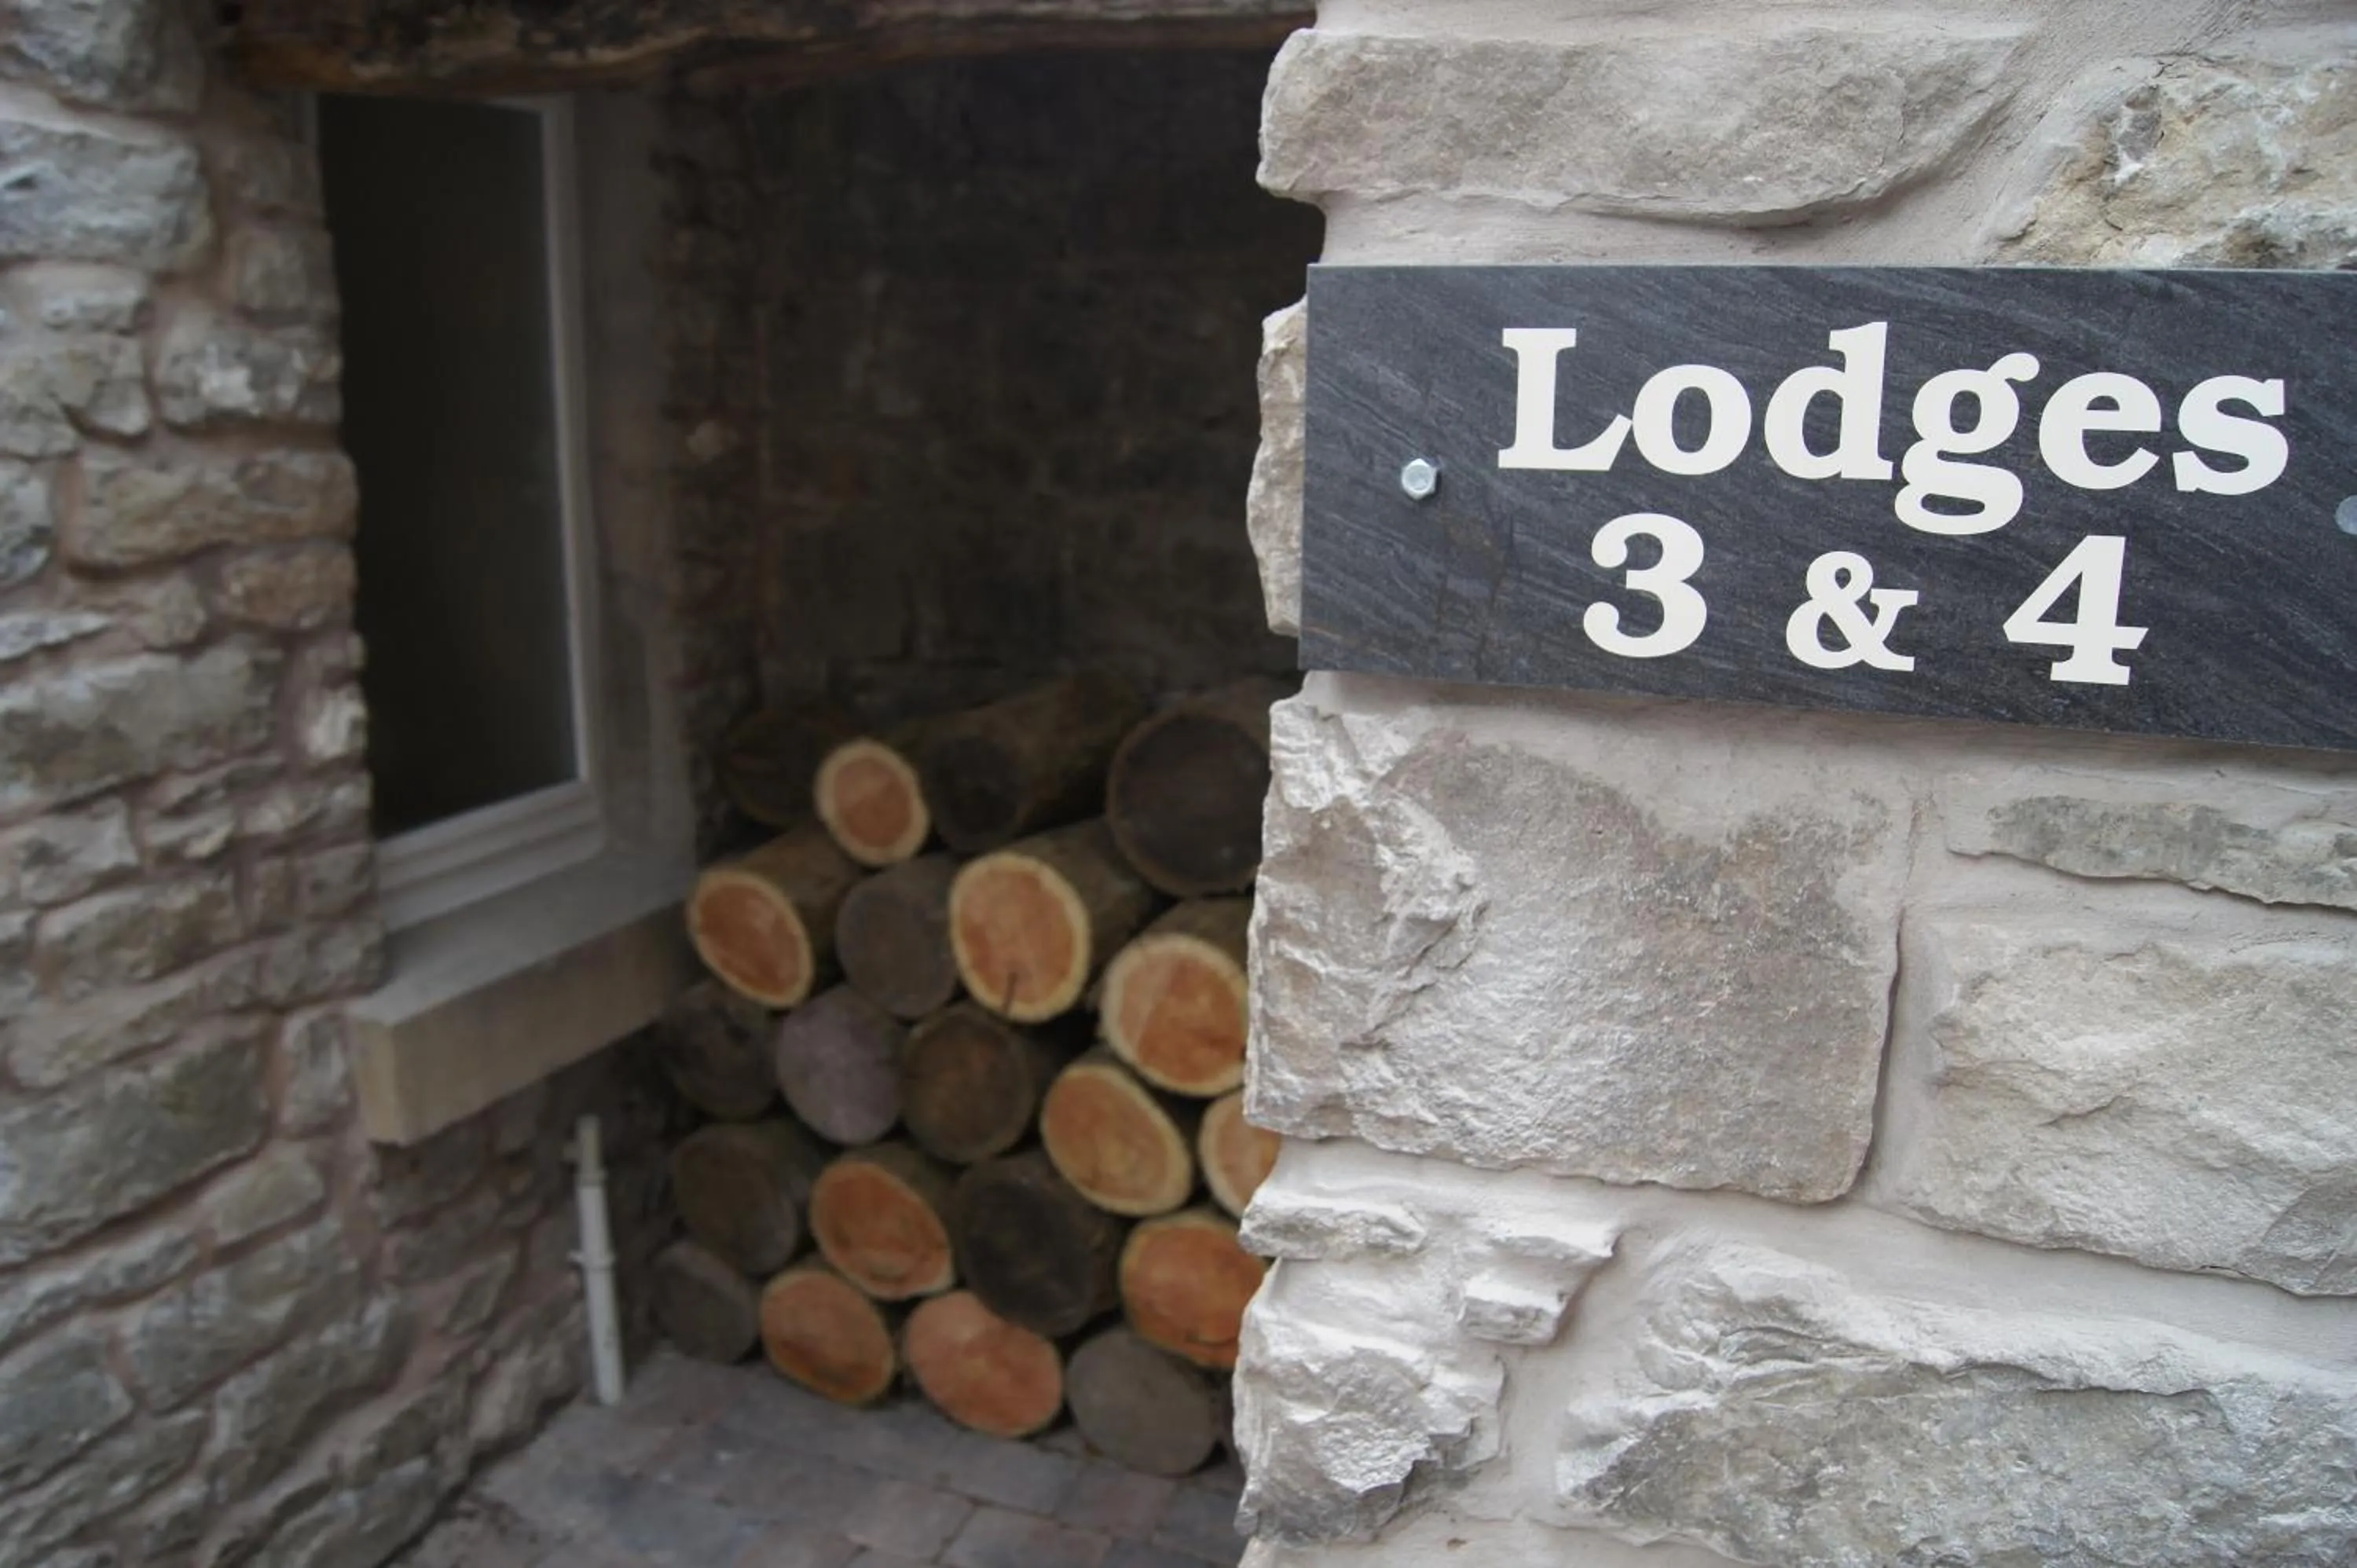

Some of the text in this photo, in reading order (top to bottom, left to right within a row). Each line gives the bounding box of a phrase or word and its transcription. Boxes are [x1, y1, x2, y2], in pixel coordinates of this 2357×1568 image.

[1497, 321, 2289, 536] Lodges
[1583, 512, 2149, 686] 3 & 4
